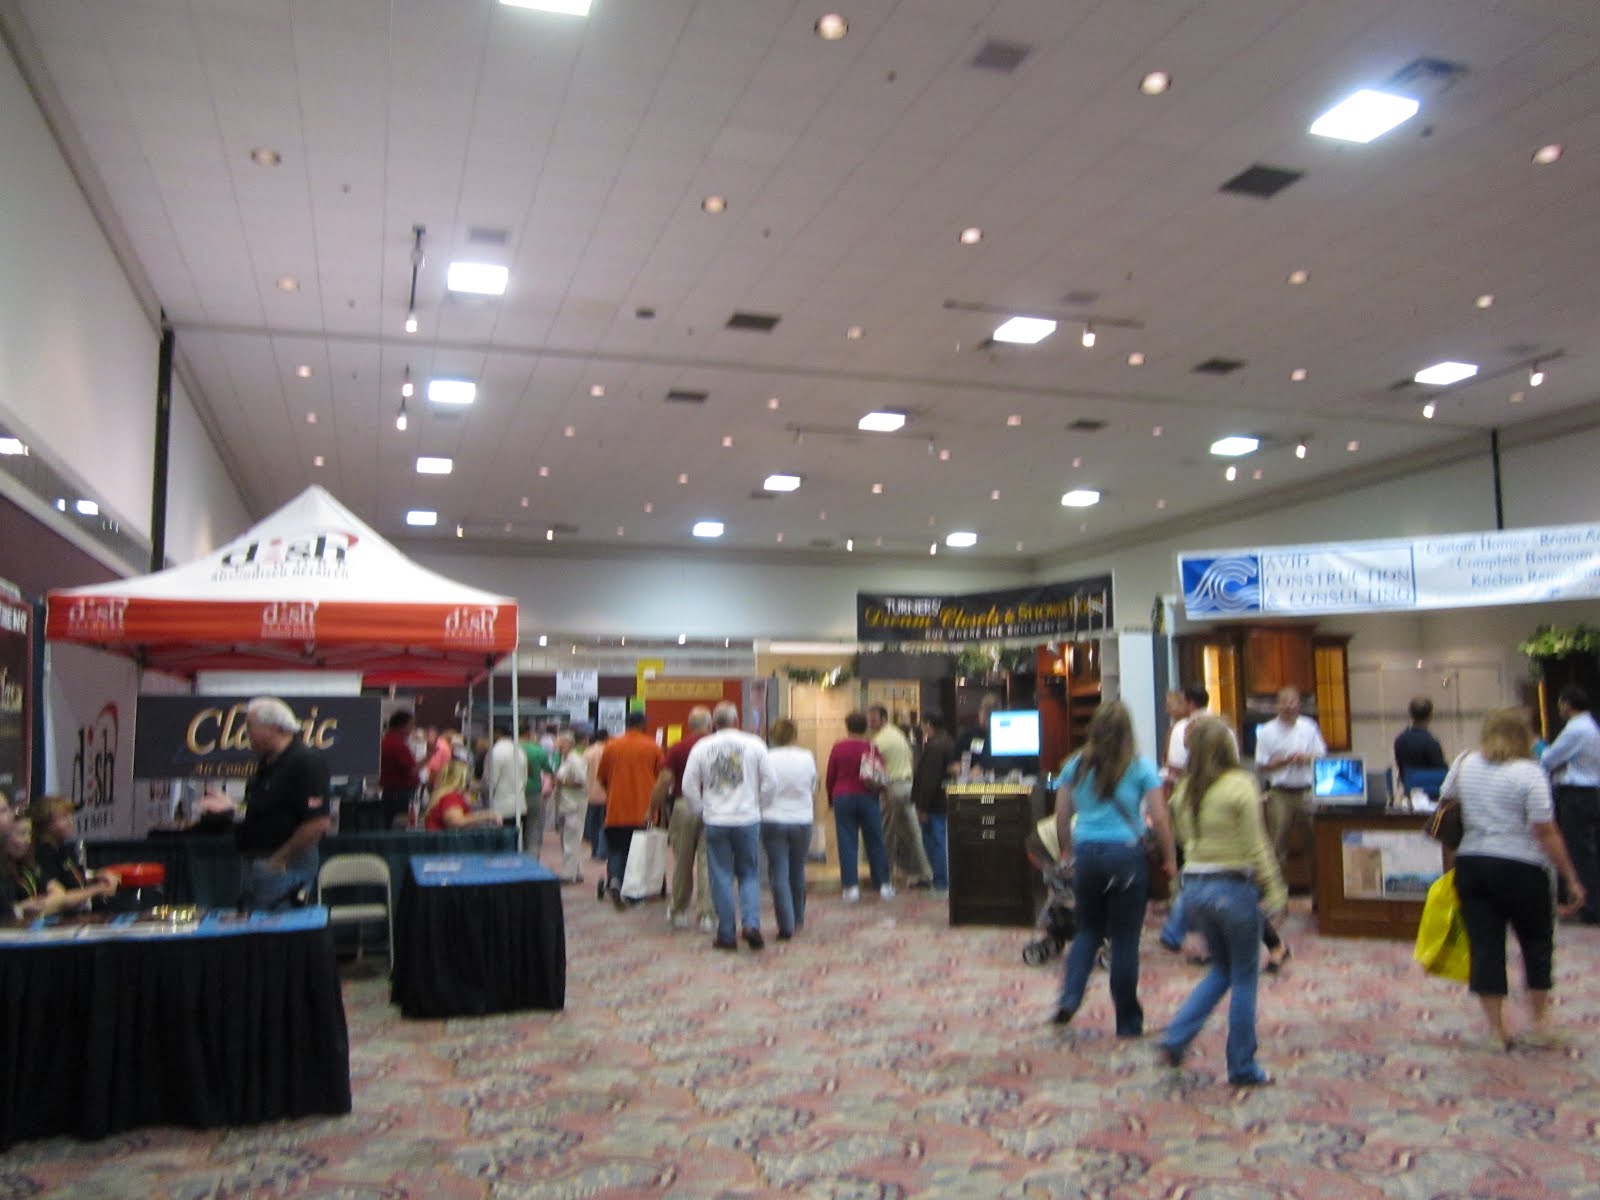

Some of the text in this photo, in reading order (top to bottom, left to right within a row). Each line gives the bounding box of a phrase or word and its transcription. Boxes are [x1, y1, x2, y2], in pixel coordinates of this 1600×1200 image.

[1264, 567, 1409, 587] CONSTRUCTION
[1288, 586, 1411, 607] CONSULTING
[69, 597, 127, 623] dish
[262, 600, 319, 625] dish
[445, 607, 498, 631] dish
[186, 704, 338, 755] Claic
[71, 725, 118, 809] dish
